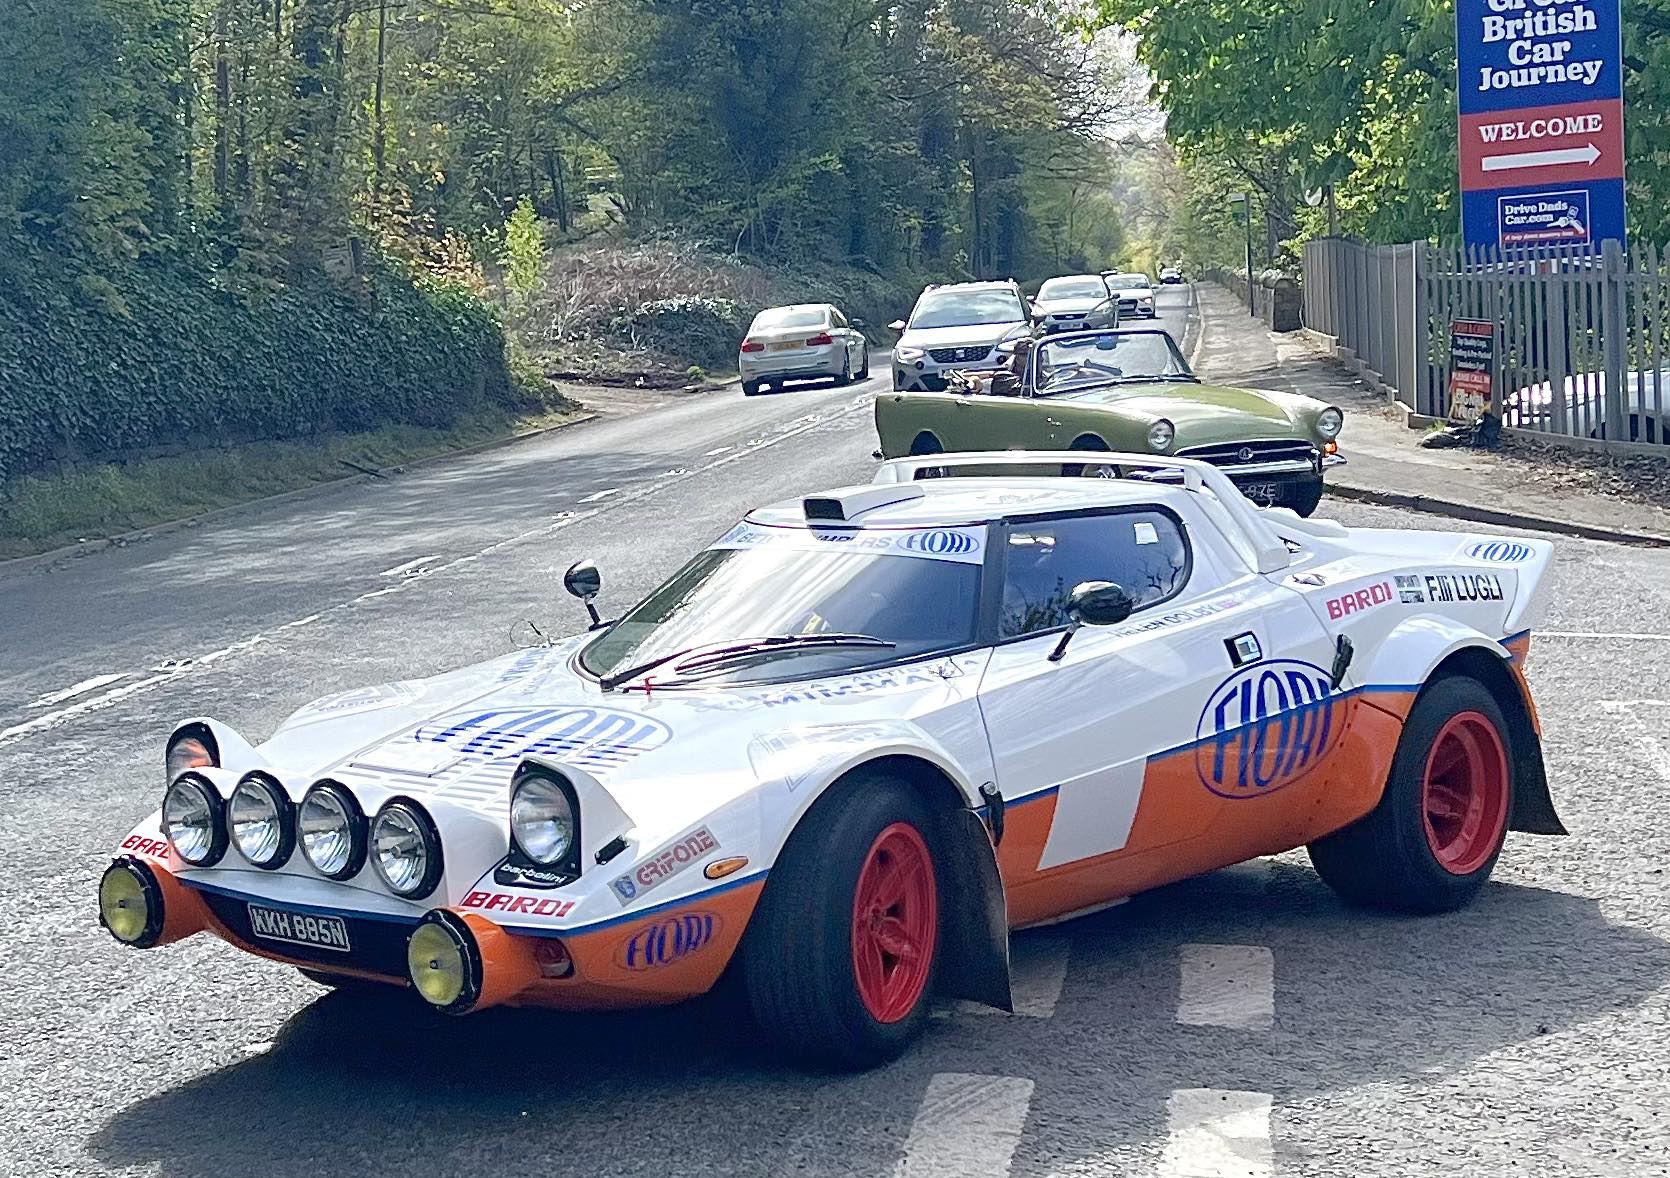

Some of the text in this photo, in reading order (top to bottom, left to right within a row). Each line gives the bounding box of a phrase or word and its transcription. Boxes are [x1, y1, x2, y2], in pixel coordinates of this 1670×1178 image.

[1482, 5, 1597, 43] British
[1508, 39, 1571, 66] Car
[1479, 60, 1603, 91] Journey
[1479, 114, 1603, 143] WELCOME
[1504, 200, 1568, 215] Drive Dads
[1504, 213, 1554, 225] Car.com
[906, 529, 972, 553] FIORI
[1471, 542, 1530, 562] FIORI
[1326, 582, 1393, 620] BARDI
[1451, 574, 1504, 602] LUGLI
[1213, 670, 1333, 788] FIORI
[500, 863, 568, 884] barbolini
[461, 891, 575, 918] BARDI
[252, 908, 345, 947] KKH 885N
[626, 914, 713, 968] FIORI
